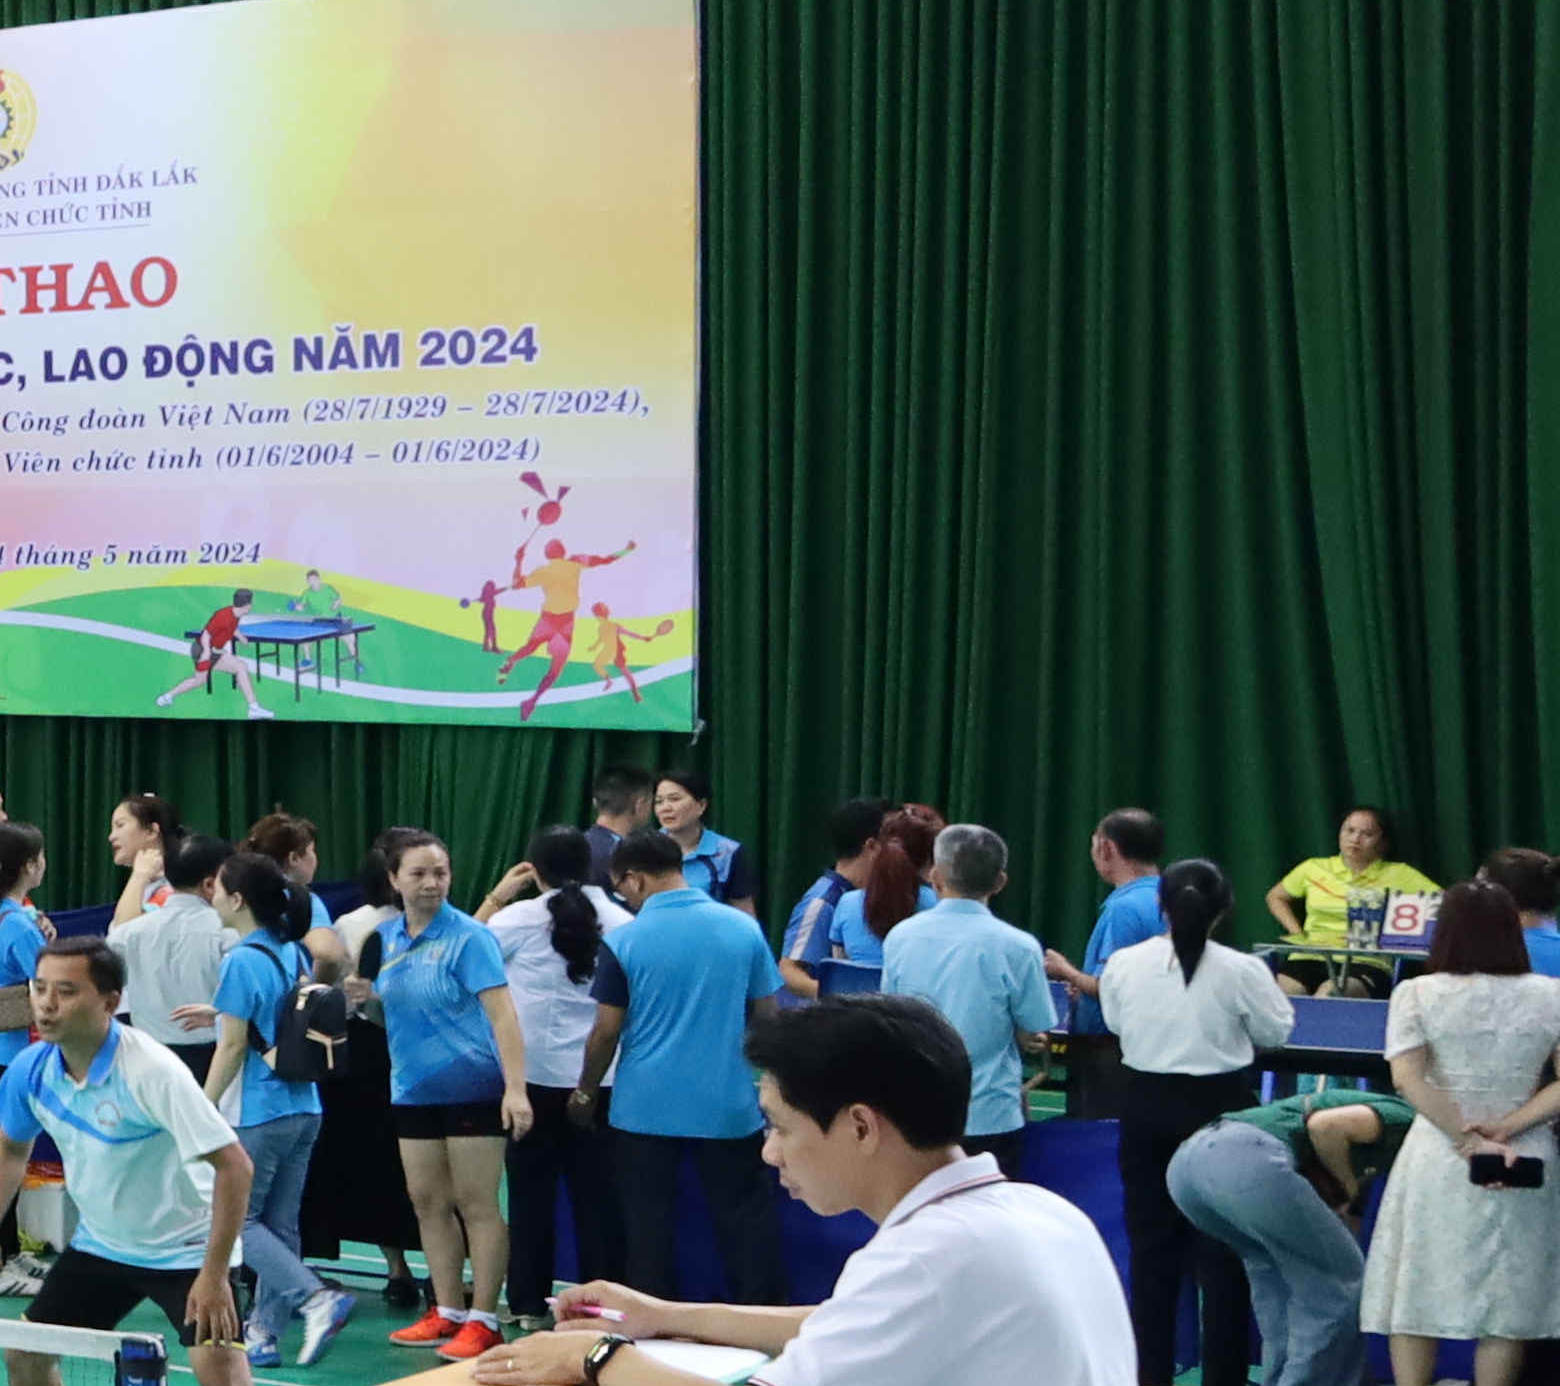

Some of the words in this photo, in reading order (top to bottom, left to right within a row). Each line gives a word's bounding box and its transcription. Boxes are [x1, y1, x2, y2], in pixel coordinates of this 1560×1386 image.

[34, 172, 88, 197] TỈNH
[96, 163, 144, 192] ĐẮK
[151, 158, 198, 186] LẮK
[26, 201, 89, 226] CHỨC
[96, 196, 152, 221] TỈNH
[44, 346, 128, 383] LAO
[143, 334, 274, 388] ĐỘNG
[293, 325, 400, 372] NĂM
[419, 326, 538, 367] 2024
[2, 410, 68, 436] Công
[79, 406, 147, 430] đoàn
[158, 404, 213, 432] Việt
[222, 401, 291, 426] Nam
[303, 394, 447, 425] (28/7/1929
[484, 388, 650, 418] 28/7/2024),
[4, 450, 61, 473] Viên
[72, 449, 136, 472] chức
[146, 446, 203, 470] tỉnh
[216, 441, 355, 470] (01/6/2004
[392, 436, 540, 464] 01/6/2024)
[14, 543, 93, 569] tháng
[103, 543, 117, 564] 5
[127, 544, 188, 565] năm
[197, 541, 261, 565] 2024
[1391, 904, 1419, 931] 8
